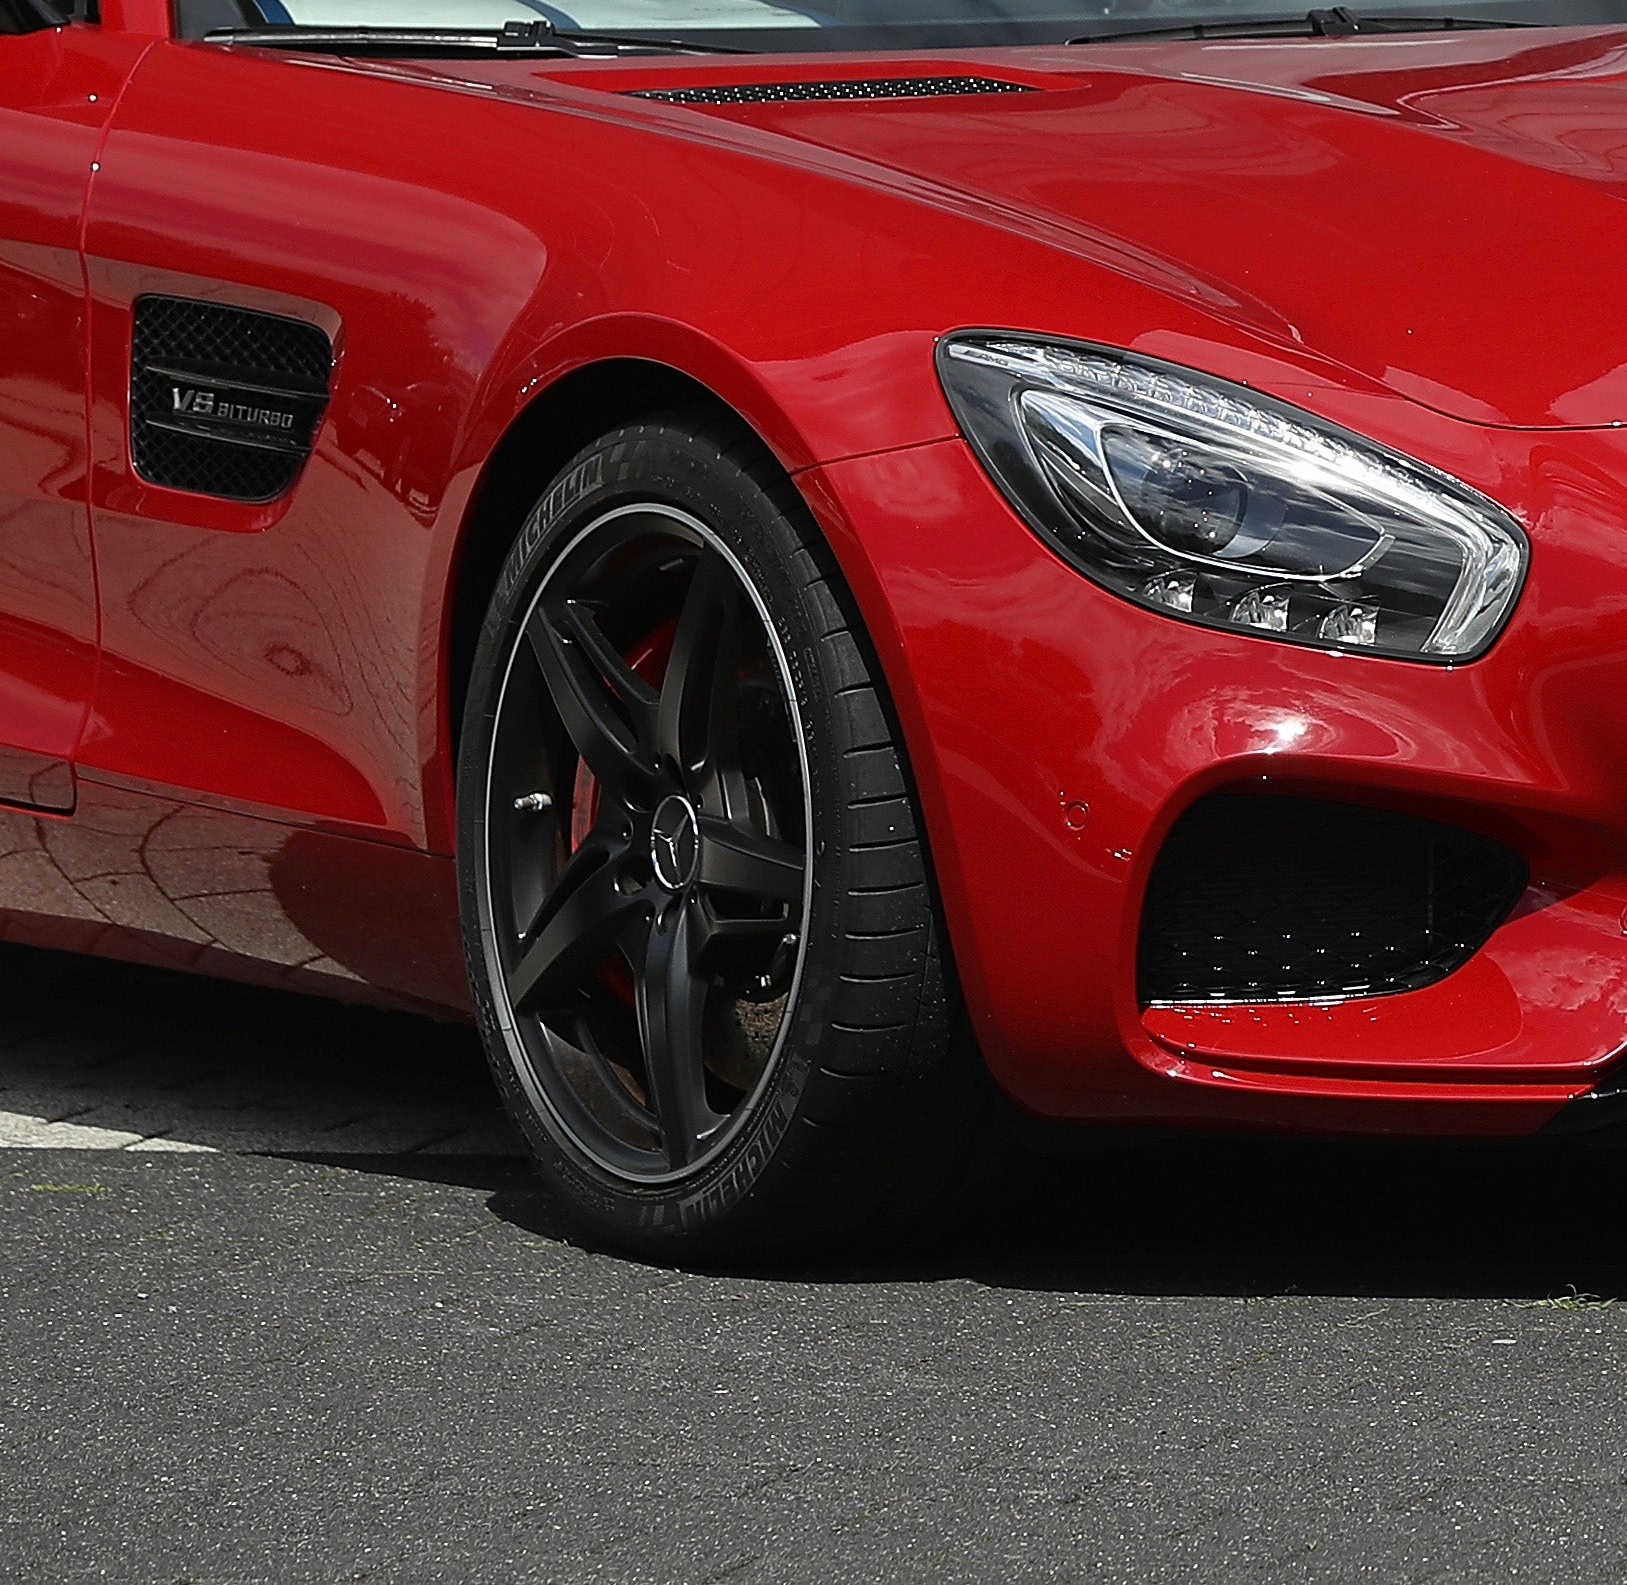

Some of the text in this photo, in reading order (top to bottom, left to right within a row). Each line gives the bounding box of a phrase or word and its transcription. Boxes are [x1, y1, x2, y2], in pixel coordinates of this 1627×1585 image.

[172, 387, 293, 428] V8 BITURBO
[504, 453, 604, 595] MICHELIN
